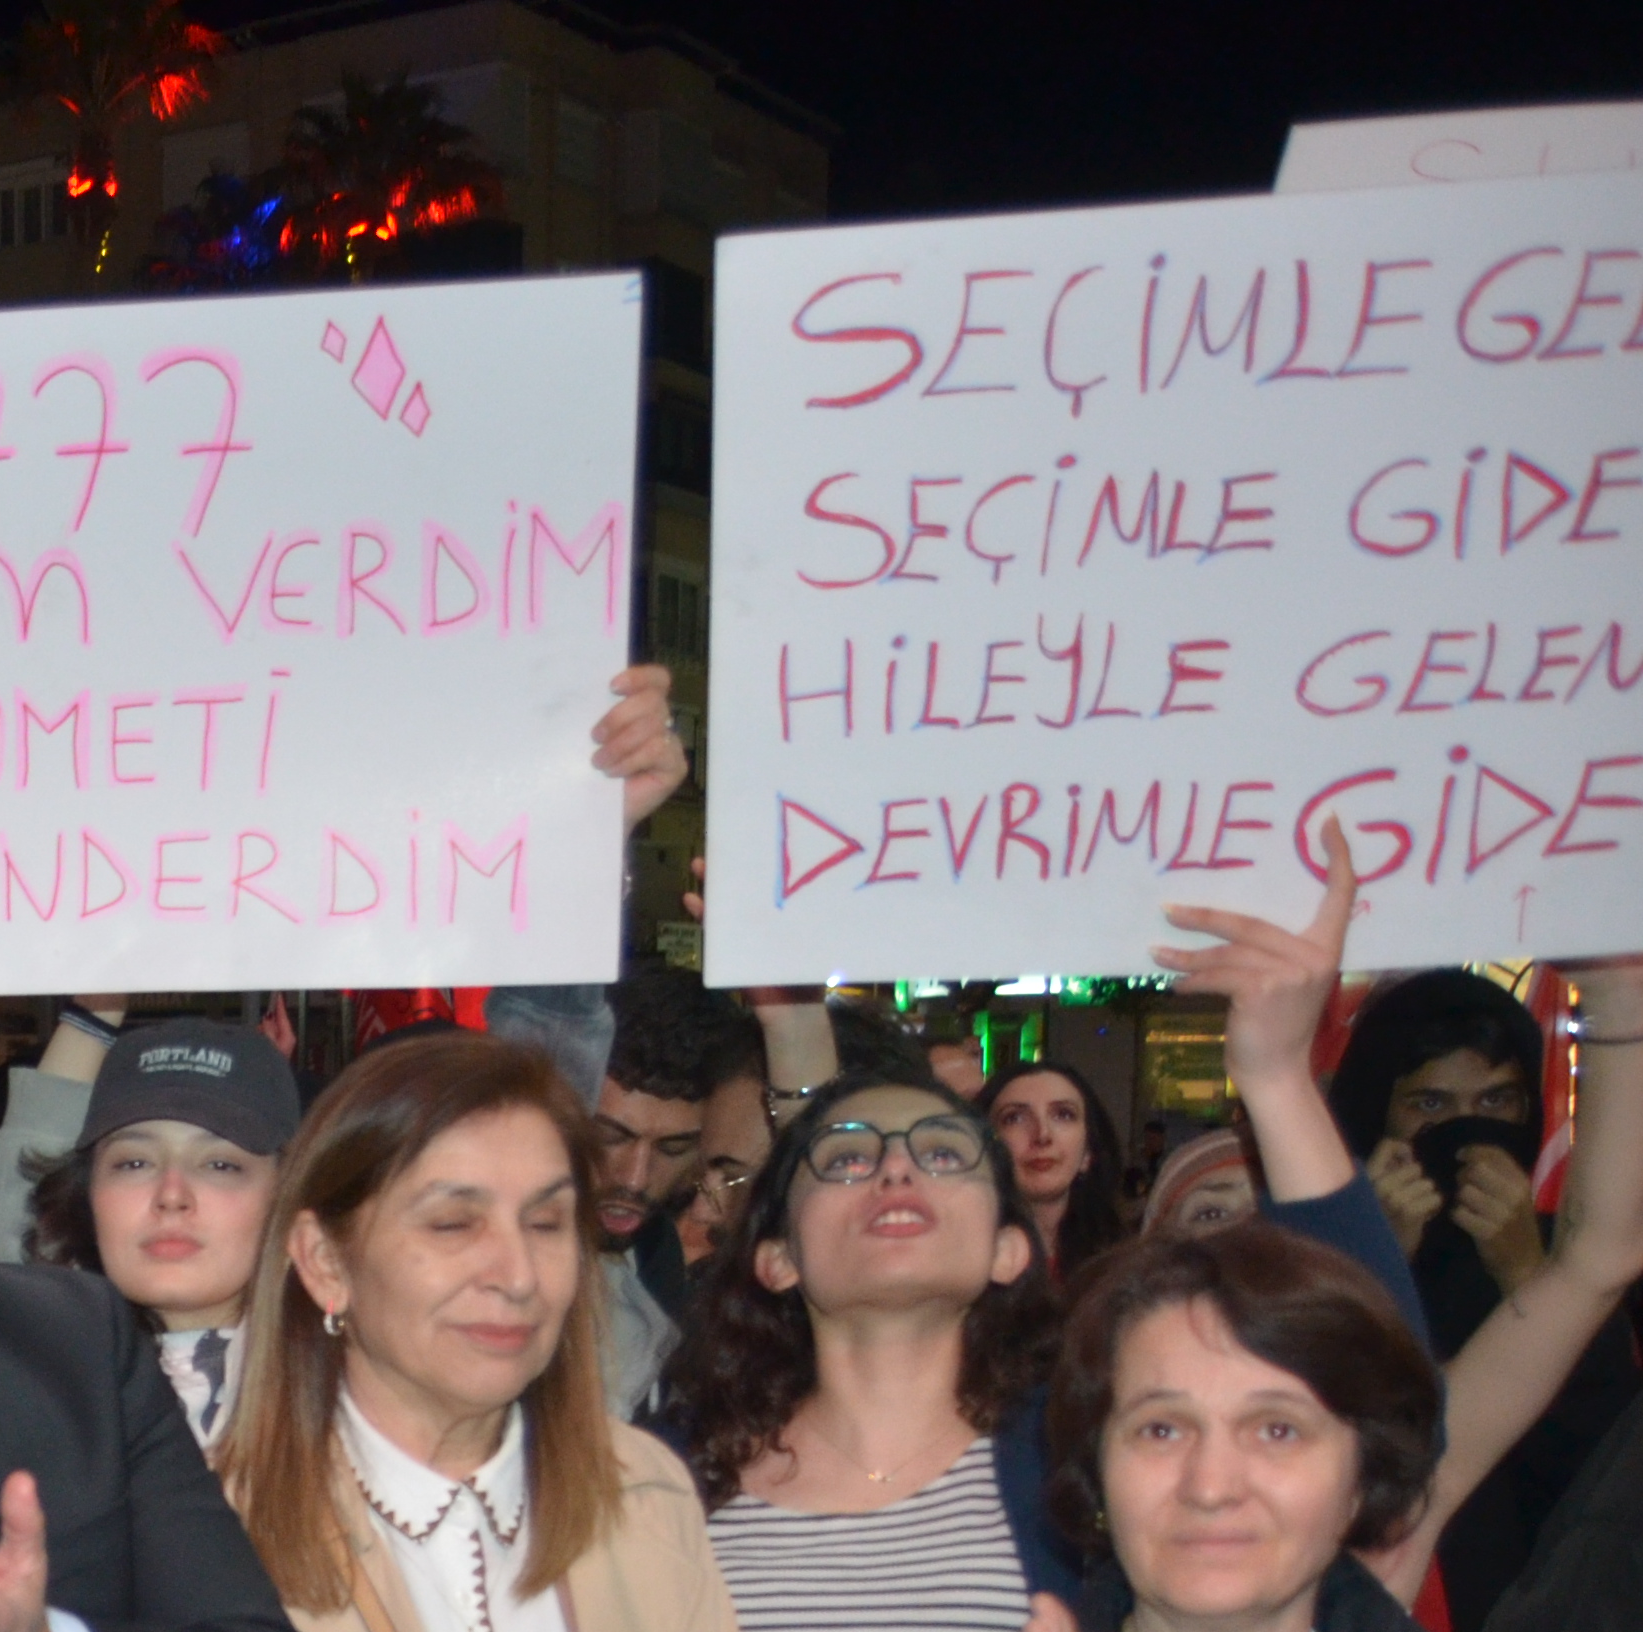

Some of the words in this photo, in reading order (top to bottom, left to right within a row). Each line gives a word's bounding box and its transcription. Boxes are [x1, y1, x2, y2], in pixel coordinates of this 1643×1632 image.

[172, 497, 623, 643] VERDİM
[796, 454, 1278, 590] SEÇİMLE
[779, 613, 1231, 743] HİLEYLE
[1295, 621, 1643, 717] GELEN
